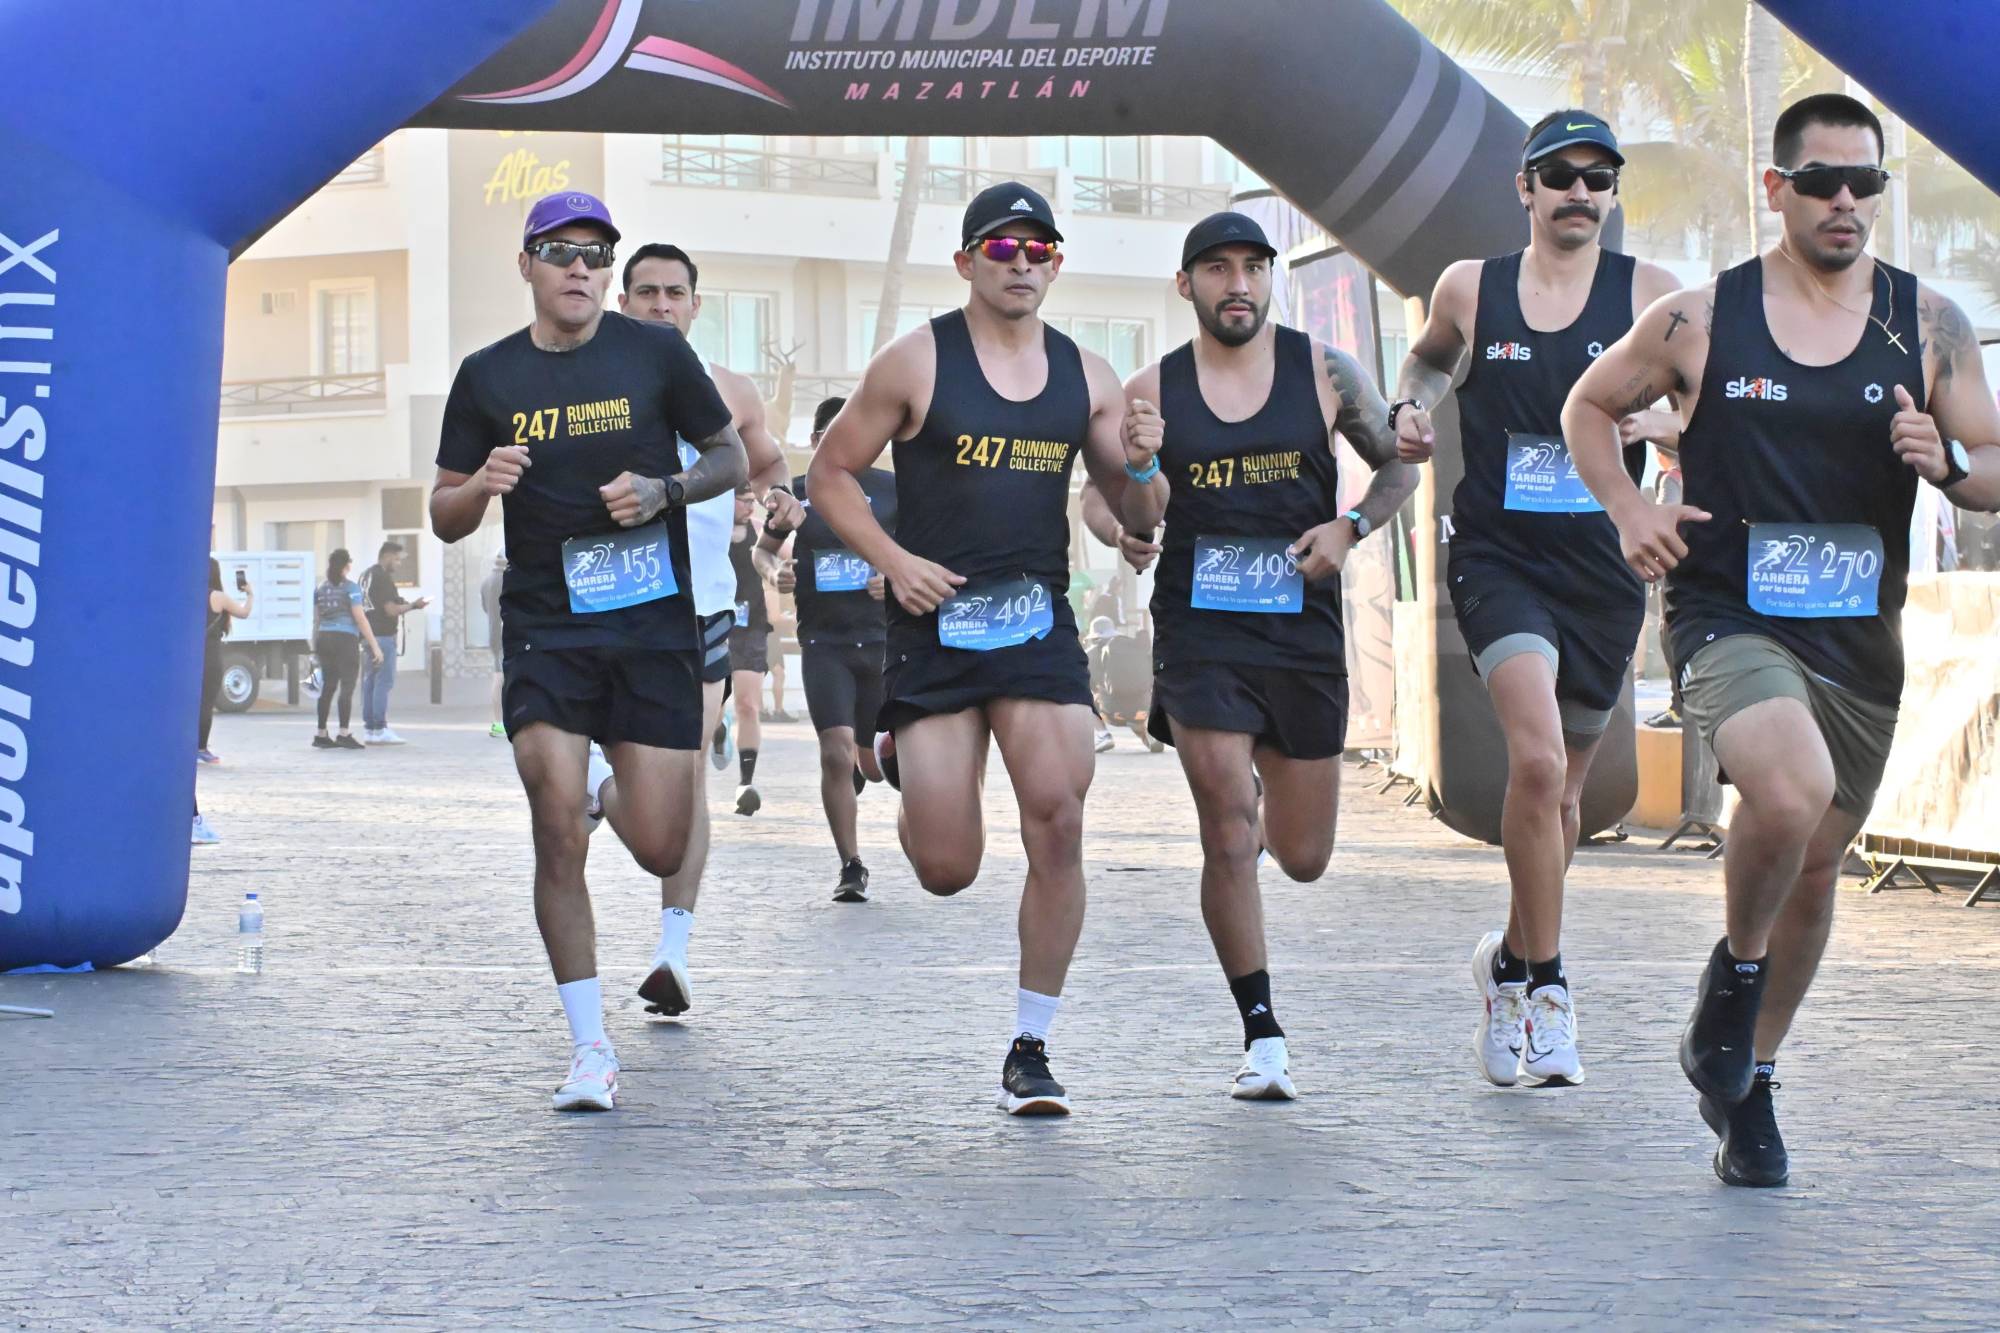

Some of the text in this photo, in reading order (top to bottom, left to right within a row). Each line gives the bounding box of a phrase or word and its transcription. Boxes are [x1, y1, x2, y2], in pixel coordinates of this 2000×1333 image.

[785, 46, 1156, 70] INSTITUTO MUNICIPAL DEL DEPORTE
[844, 75, 1092, 101] MAZATLÁN
[484, 147, 570, 206] Altas
[1486, 341, 1531, 361] skills
[1725, 376, 1788, 401] skills
[566, 397, 631, 423] RUNNING
[512, 407, 560, 444] 247
[568, 416, 632, 436] COLLECTIVE
[956, 434, 1006, 468] 247
[1011, 438, 1069, 459] RUNNING
[1009, 457, 1064, 473] COLLECTIVE
[1189, 457, 1235, 488] 247
[1242, 450, 1301, 472] RUNNING
[1244, 467, 1299, 485] COLLECTIVE
[1509, 472, 1556, 485] CARRERA
[621, 542, 661, 583] 155
[843, 558, 871, 585] 154
[1245, 543, 1298, 590] 498
[1819, 541, 1877, 595] 270
[569, 573, 617, 589] CARRERA
[1196, 573, 1241, 585] CARRERA
[1752, 571, 1810, 585] CARRERA
[1759, 584, 1773, 593] por
[1783, 586, 1806, 595] salud
[994, 583, 1047, 631] 492
[941, 621, 989, 632] CARRERA
